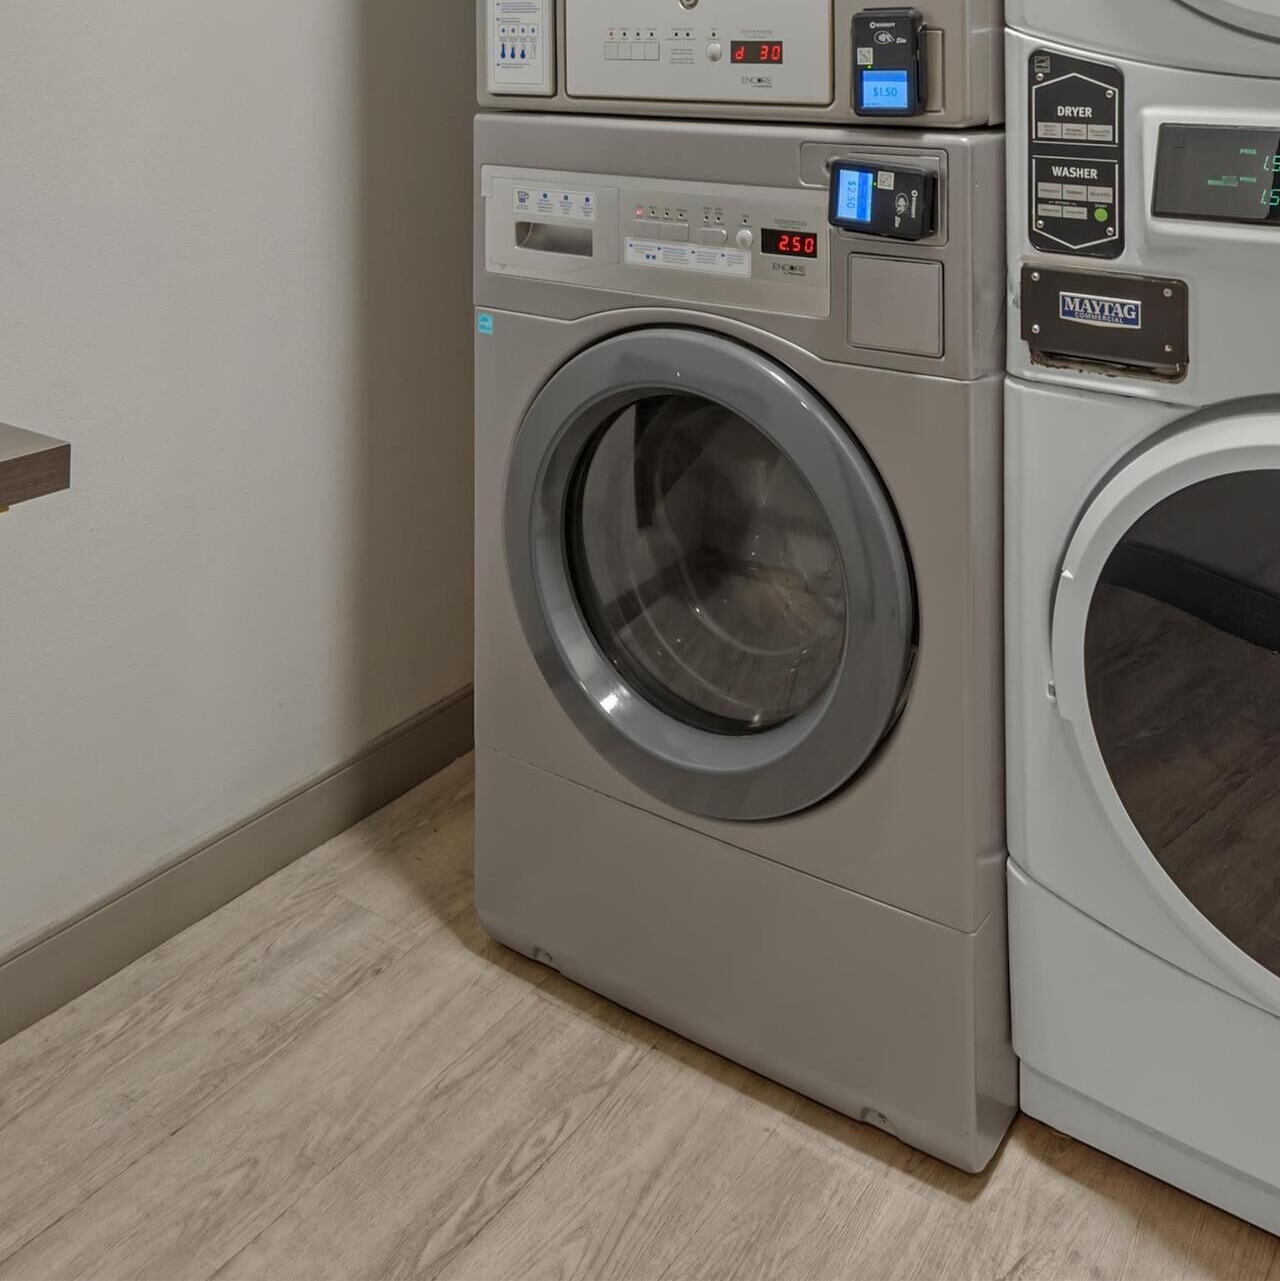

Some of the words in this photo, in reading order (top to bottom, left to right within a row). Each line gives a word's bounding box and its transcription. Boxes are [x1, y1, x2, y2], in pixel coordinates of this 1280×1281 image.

[759, 45, 781, 61] 30
[741, 76, 773, 85] ENCORE
[873, 86, 898, 98] $1.50
[1057, 105, 1093, 118] DRYER
[1051, 165, 1098, 179] WASHER
[846, 180, 857, 209] $2.50
[778, 234, 815, 253] 2.50
[772, 262, 806, 273] ENCORE
[1064, 296, 1136, 319] MAYTAG
[1075, 311, 1124, 324] COMMERCIAL
